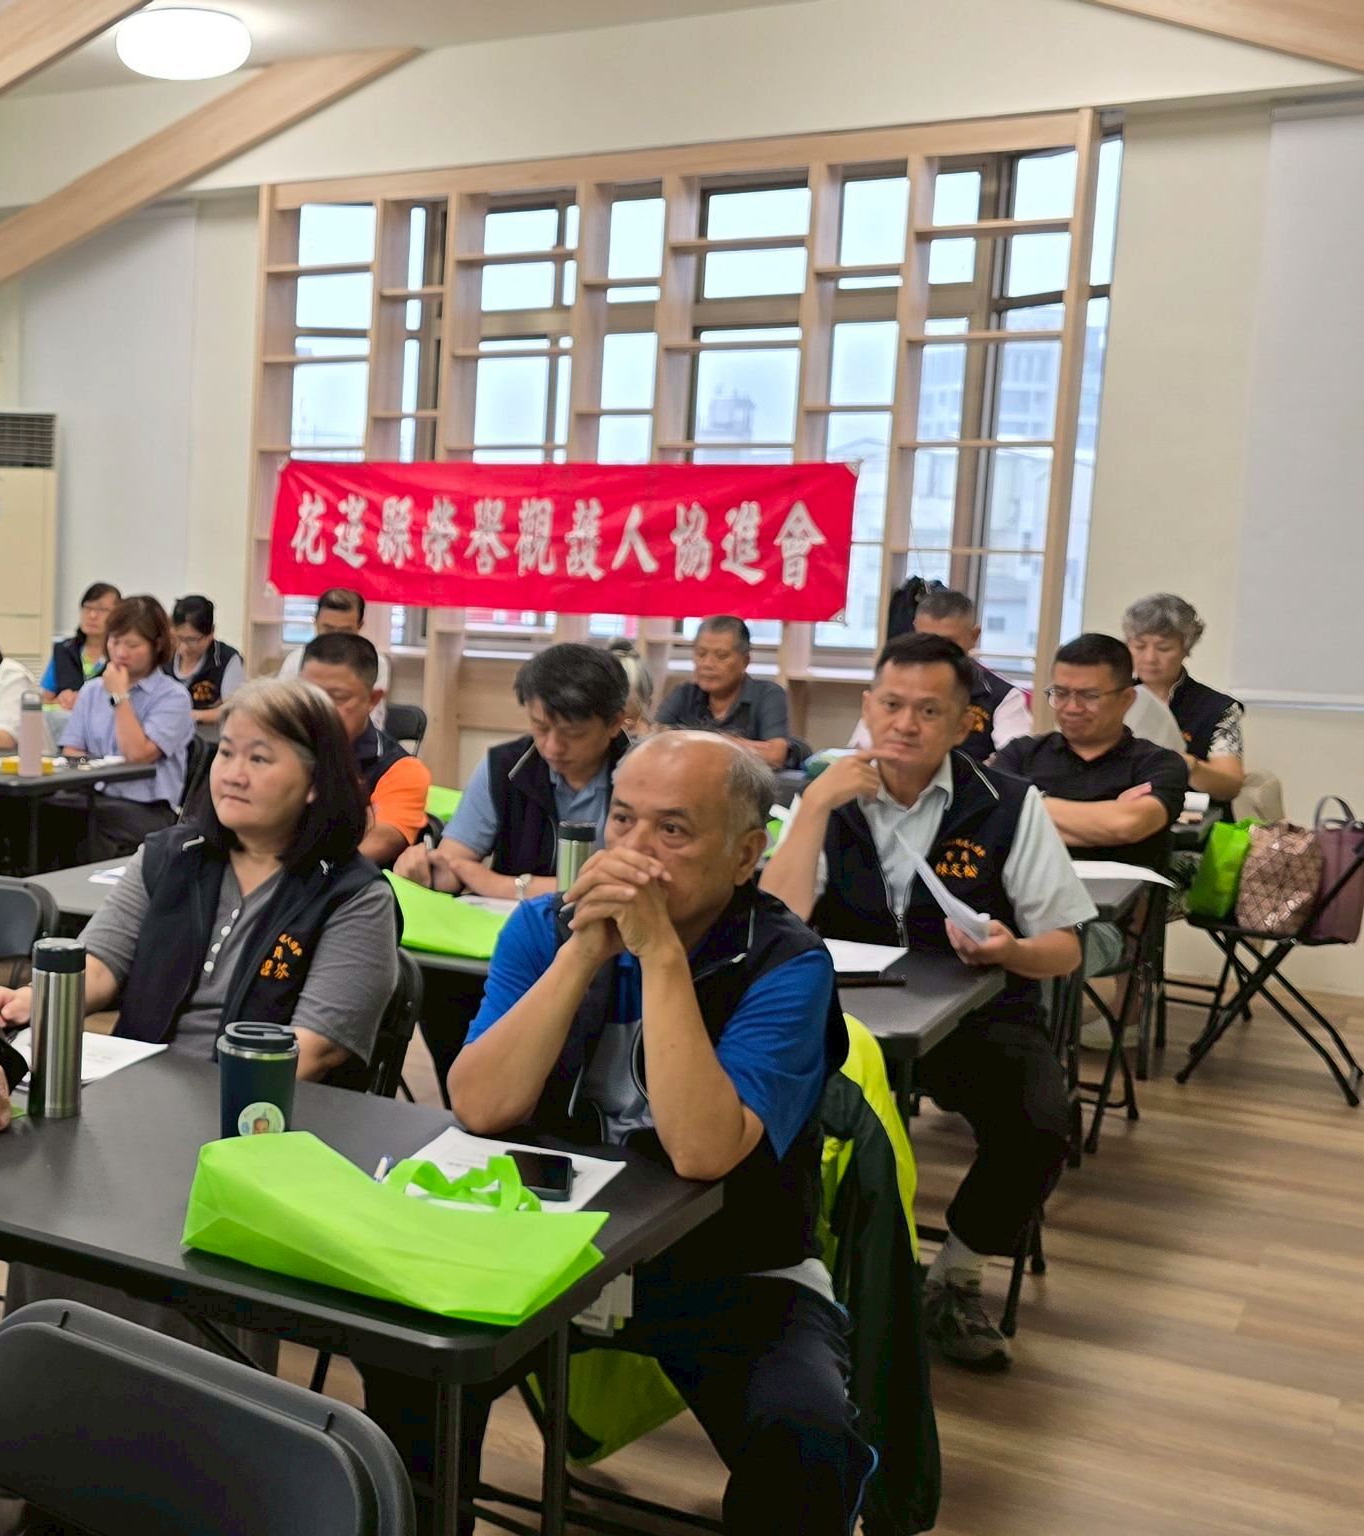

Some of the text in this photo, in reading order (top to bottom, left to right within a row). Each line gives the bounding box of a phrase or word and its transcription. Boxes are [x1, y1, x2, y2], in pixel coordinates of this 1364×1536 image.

[291, 491, 827, 590] 花蓮縣榮譽觀護人協進會
